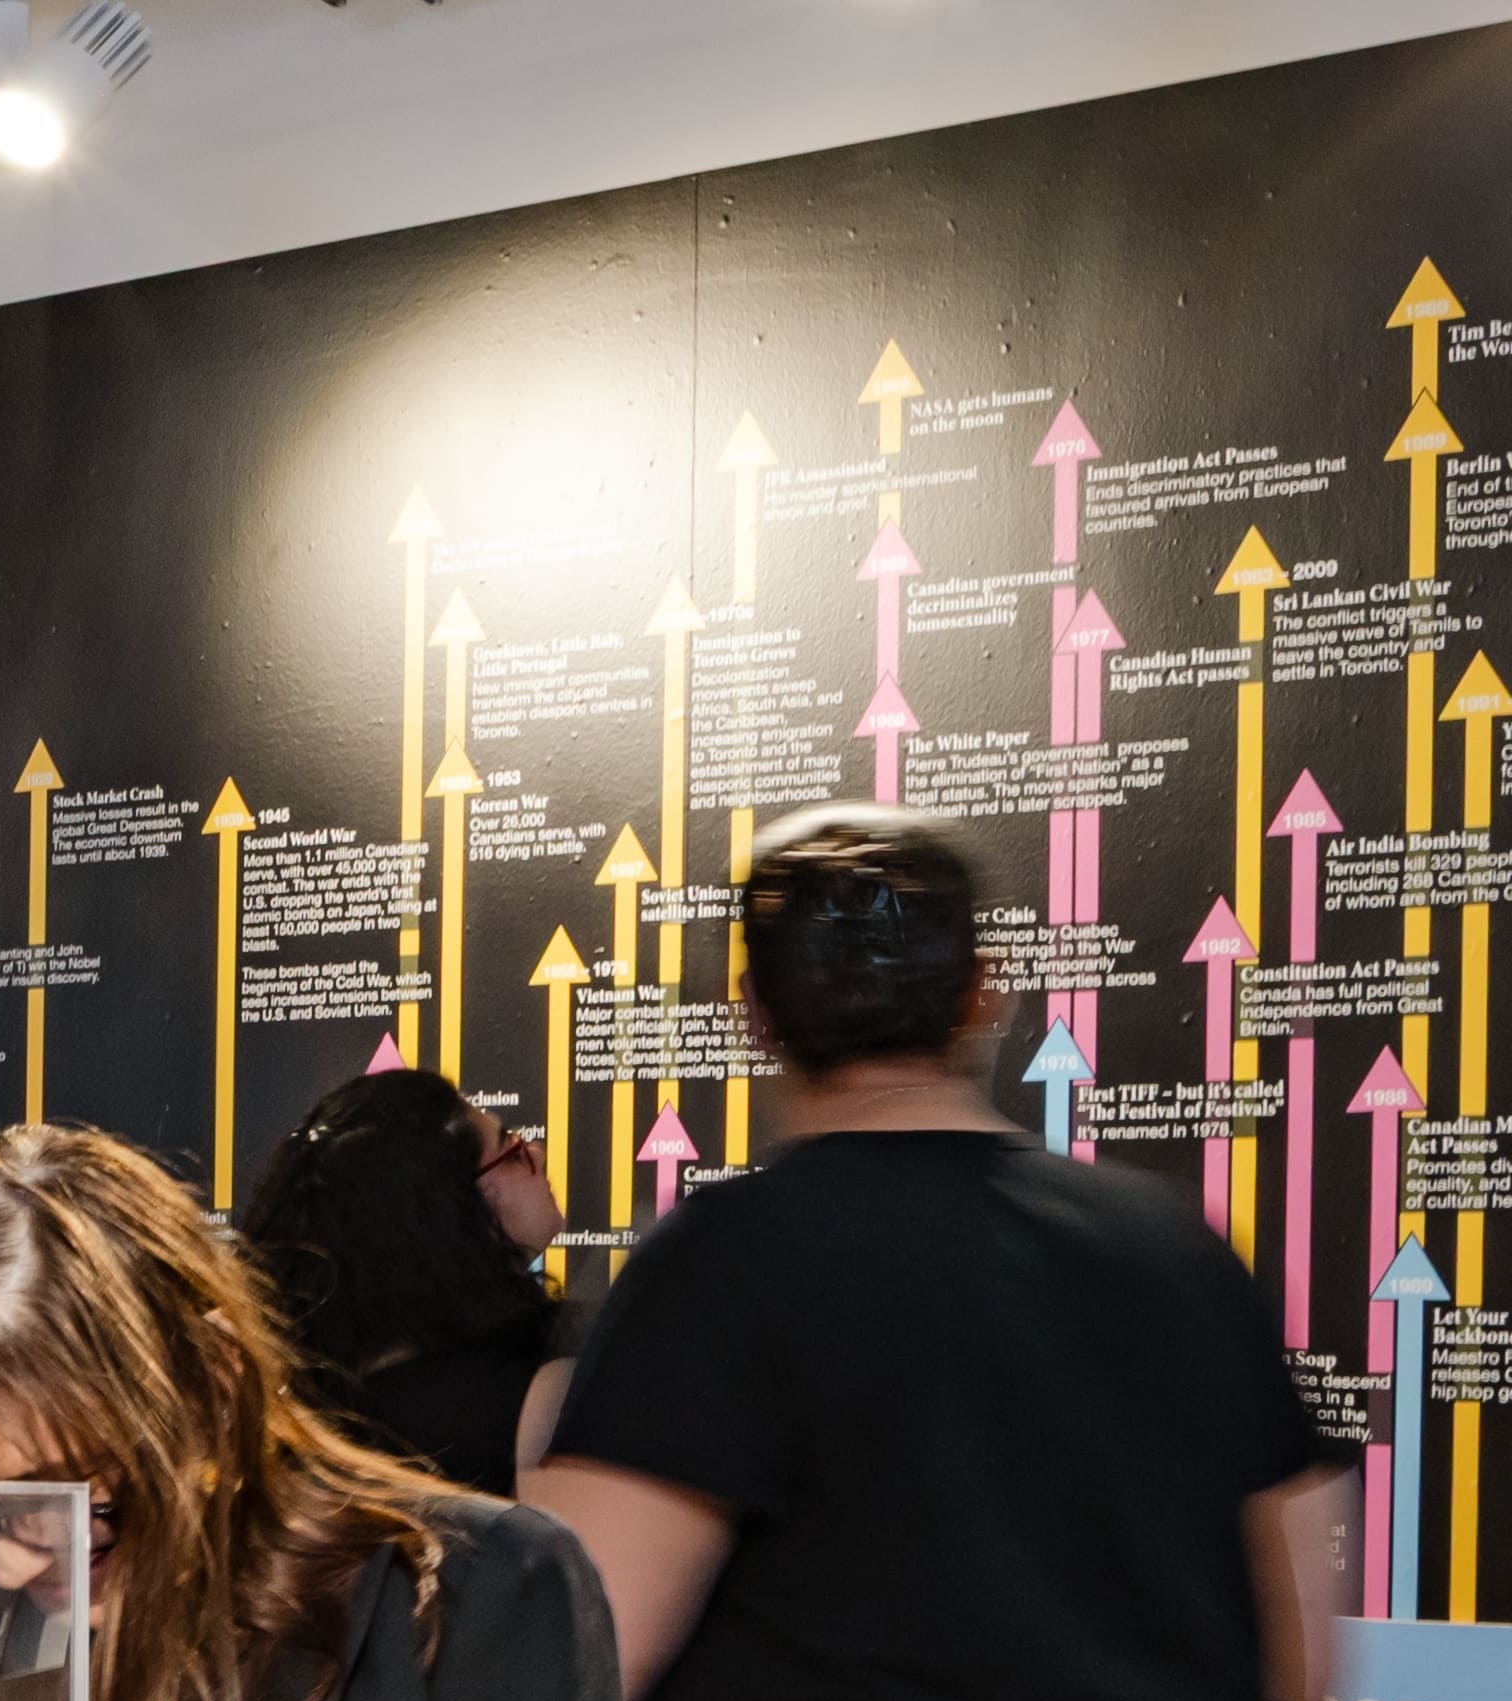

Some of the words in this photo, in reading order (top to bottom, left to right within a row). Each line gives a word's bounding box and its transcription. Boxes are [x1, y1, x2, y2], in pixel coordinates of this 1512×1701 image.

[911, 399, 953, 417] NASA
[958, 396, 987, 414] gets
[992, 388, 1052, 406] humans
[1087, 456, 1188, 482] Immigration
[1193, 451, 1220, 469] Act
[1225, 447, 1277, 465] Passes
[1294, 560, 1338, 579] 2009
[1274, 593, 1297, 612] Sri
[1302, 588, 1365, 609] Lankan
[1370, 582, 1410, 601] Civil
[1416, 580, 1451, 596] War
[1110, 651, 1186, 672] Canadian
[1191, 647, 1251, 665] Human
[1110, 671, 1162, 690] Rights
[1166, 669, 1193, 685] Act
[1198, 666, 1249, 685] passes
[53, 793, 83, 808] Stock
[87, 789, 126, 804] Market
[130, 785, 163, 800] Crash
[471, 799, 517, 813] Korean
[521, 795, 548, 809] War
[244, 832, 287, 849] Second
[290, 829, 327, 846] World
[330, 828, 356, 842] War
[1326, 838, 1354, 856] Air
[1359, 835, 1403, 854] India
[1409, 832, 1489, 851] Bombing
[1241, 963, 1346, 983] Constitution
[1350, 961, 1379, 978] Act
[1384, 960, 1439, 976] Passes
[576, 988, 634, 1003] Vietnam
[638, 986, 666, 1000] War
